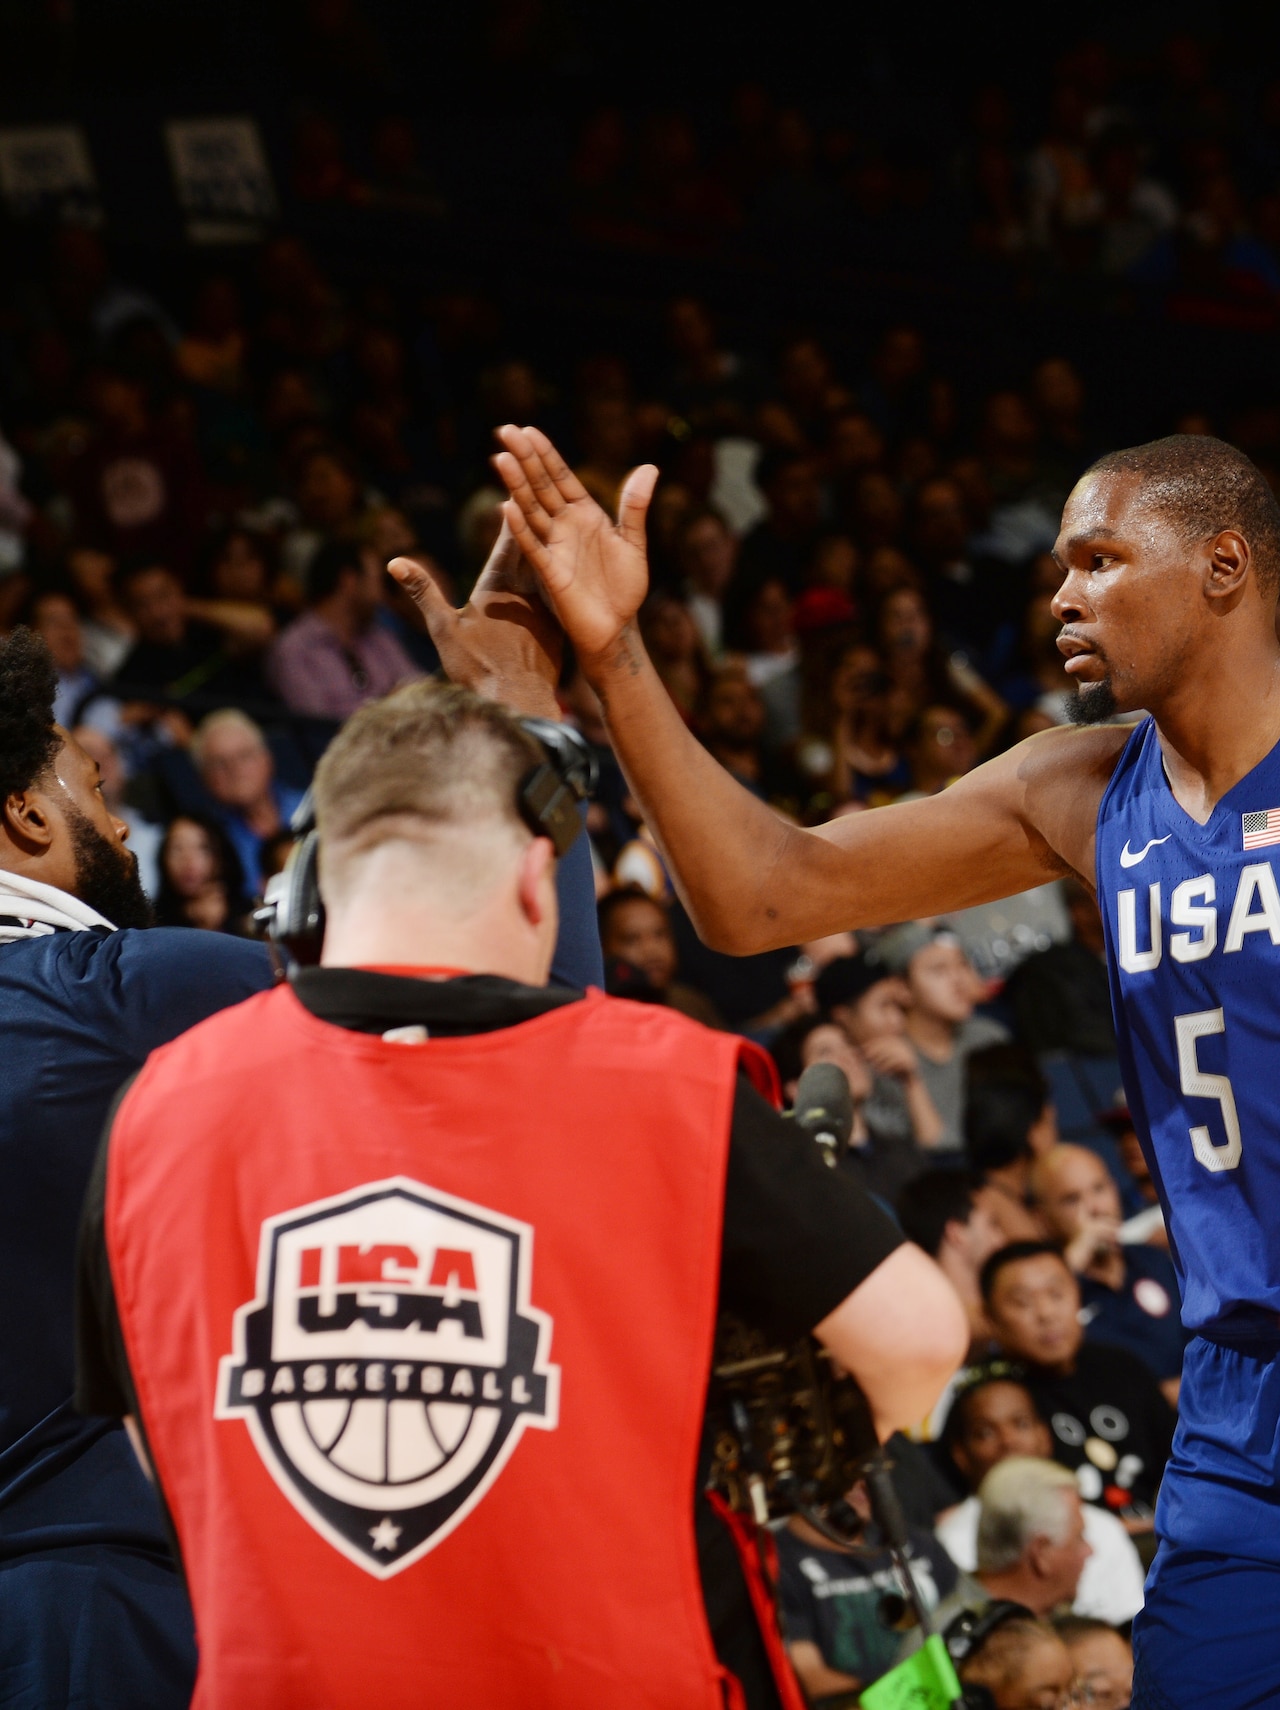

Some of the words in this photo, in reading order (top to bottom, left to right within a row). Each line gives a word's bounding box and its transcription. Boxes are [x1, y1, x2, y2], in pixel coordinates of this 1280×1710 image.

[1173, 1006, 1243, 1173] 5
[297, 1243, 485, 1341] USA
[240, 1363, 532, 1405] BASKETBALL
